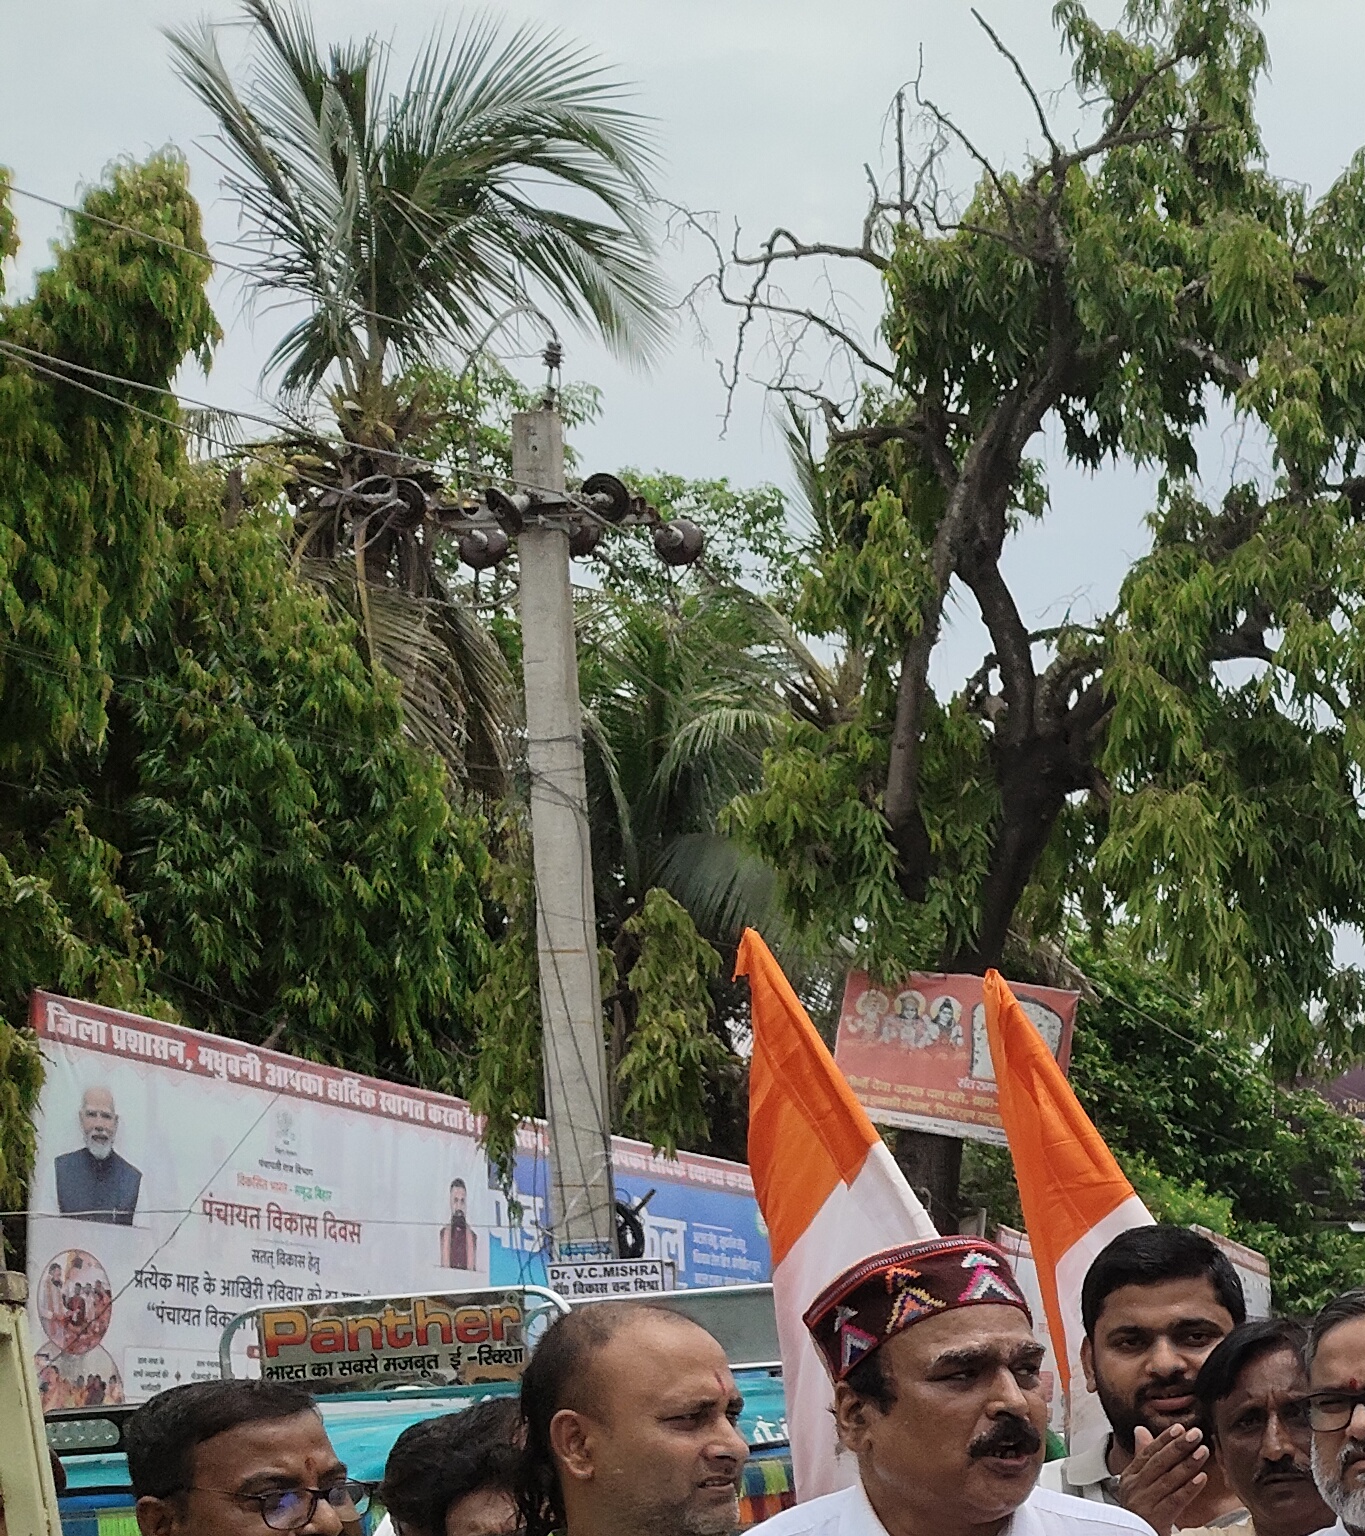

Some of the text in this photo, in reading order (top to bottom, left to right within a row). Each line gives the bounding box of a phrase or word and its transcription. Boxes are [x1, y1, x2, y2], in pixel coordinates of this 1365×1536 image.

[47, 1001, 108, 1046] जिला
[111, 1024, 193, 1071] प्रशासन,
[265, 1063, 324, 1097] आपका
[327, 1076, 377, 1109] हार्दिक
[380, 1091, 425, 1121] स्वागत
[429, 1104, 464, 1130] करता
[202, 1192, 361, 1244] पंचायत विकास दिवस
[276, 1250, 306, 1269] विकास
[550, 1264, 660, 1280] Dr. V.C.MISHRA
[134, 1265, 173, 1291] प्रत्येक
[177, 1274, 200, 1297] माह
[203, 1271, 216, 1294] के
[220, 1275, 264, 1299] आखिरी
[262, 1299, 522, 1358] Panther
[266, 1363, 307, 1381] भारत
[312, 1361, 334, 1377] का
[338, 1354, 379, 1377] सबसे
[382, 1354, 439, 1378] मजबूत
[450, 1346, 461, 1372] ई
